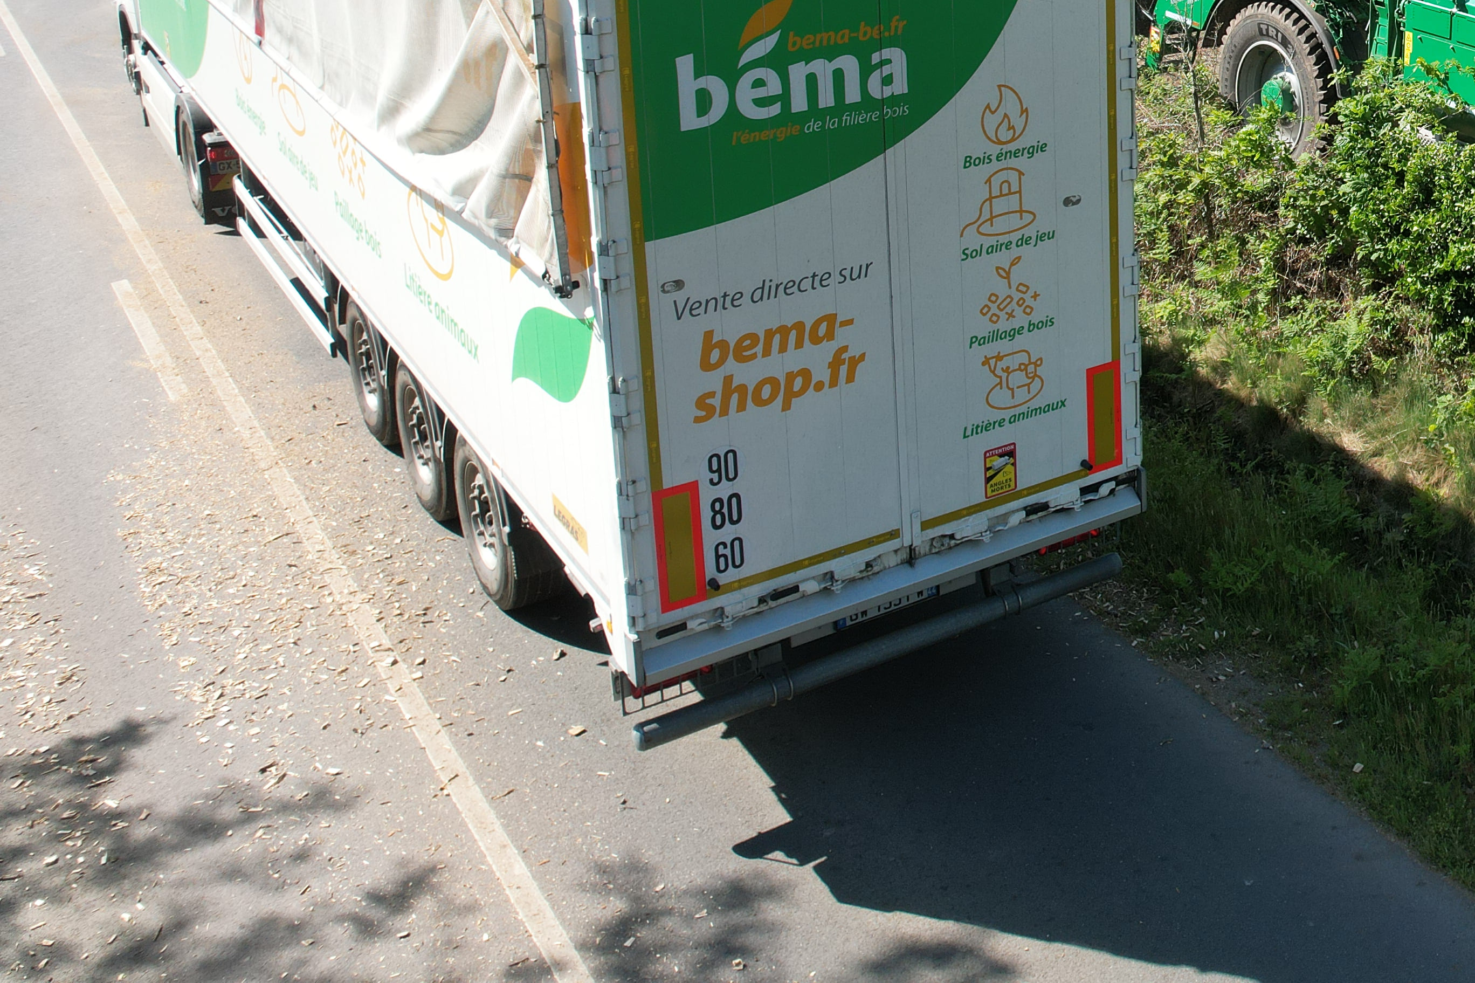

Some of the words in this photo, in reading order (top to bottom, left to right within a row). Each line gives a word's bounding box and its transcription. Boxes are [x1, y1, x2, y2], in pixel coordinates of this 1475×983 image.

[787, 15, 907, 52] bema-be.fr
[1259, 23, 1283, 43] TRI
[731, 122, 801, 146] l'énergie
[804, 118, 822, 134] de
[825, 114, 838, 130] la
[841, 108, 880, 128] filière
[883, 103, 910, 120] bois
[962, 151, 993, 170] Bois
[995, 140, 1048, 163] énergie
[960, 243, 984, 262] Sol
[986, 239, 1013, 256] aire
[1015, 233, 1033, 248] de
[1033, 229, 1056, 248] jeu
[672, 290, 744, 321] Vente
[750, 270, 832, 304] directe
[837, 261, 874, 285] sur
[434, 304, 480, 364] animaux
[699, 312, 855, 373] bema-
[968, 323, 1025, 350] Paillage
[1027, 315, 1056, 333] bois
[692, 344, 867, 425] shop.fr
[962, 416, 1006, 440] Litière
[1008, 398, 1068, 426] animaux
[707, 448, 739, 487] 90
[985, 444, 1015, 458] ATTENTION
[989, 477, 1012, 489] ANGLES
[990, 484, 1012, 494] MORTS
[710, 492, 743, 531] 80
[713, 536, 745, 575] 60
